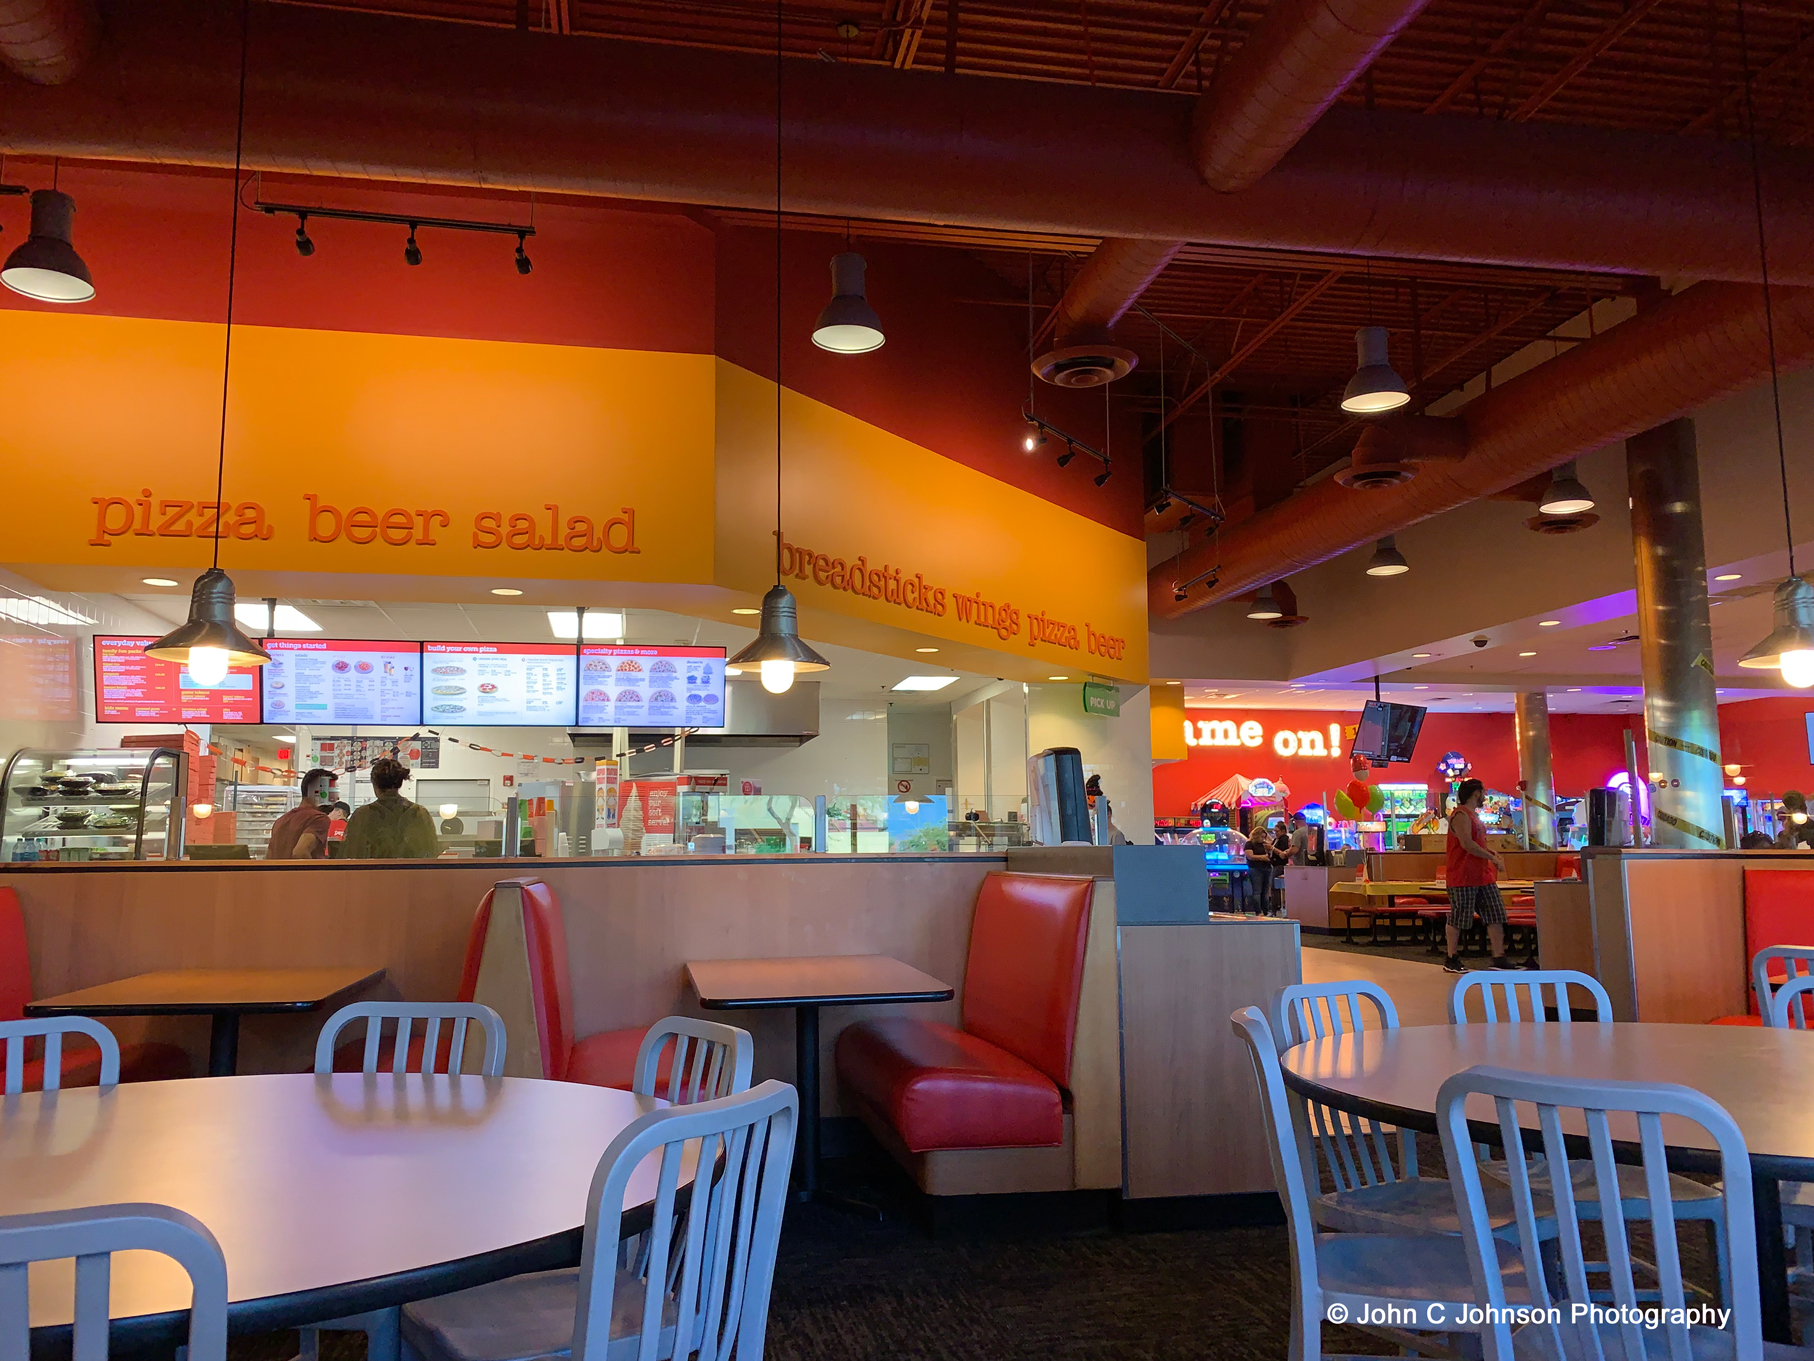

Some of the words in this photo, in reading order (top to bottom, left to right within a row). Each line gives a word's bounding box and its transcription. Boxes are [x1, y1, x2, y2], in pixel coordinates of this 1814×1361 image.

[88, 488, 274, 547] pizza
[303, 493, 450, 546] beer
[472, 504, 642, 555] salad
[772, 530, 947, 617] breadsticks
[952, 591, 1020, 640] wings
[1027, 610, 1080, 650] pizza
[1085, 622, 1126, 661] beer
[101, 639, 135, 647] everyday
[279, 642, 301, 650] things
[583, 648, 613, 656] specialty
[613, 648, 634, 656] pizzas
[1090, 696, 1105, 709] PICK
[1106, 699, 1116, 710] UP
[1273, 722, 1343, 758] on!
[1655, 734, 1678, 748] CAUTION
[649, 789, 669, 799] enjoy
[648, 799, 662, 808] our
[648, 809, 663, 817] soft
